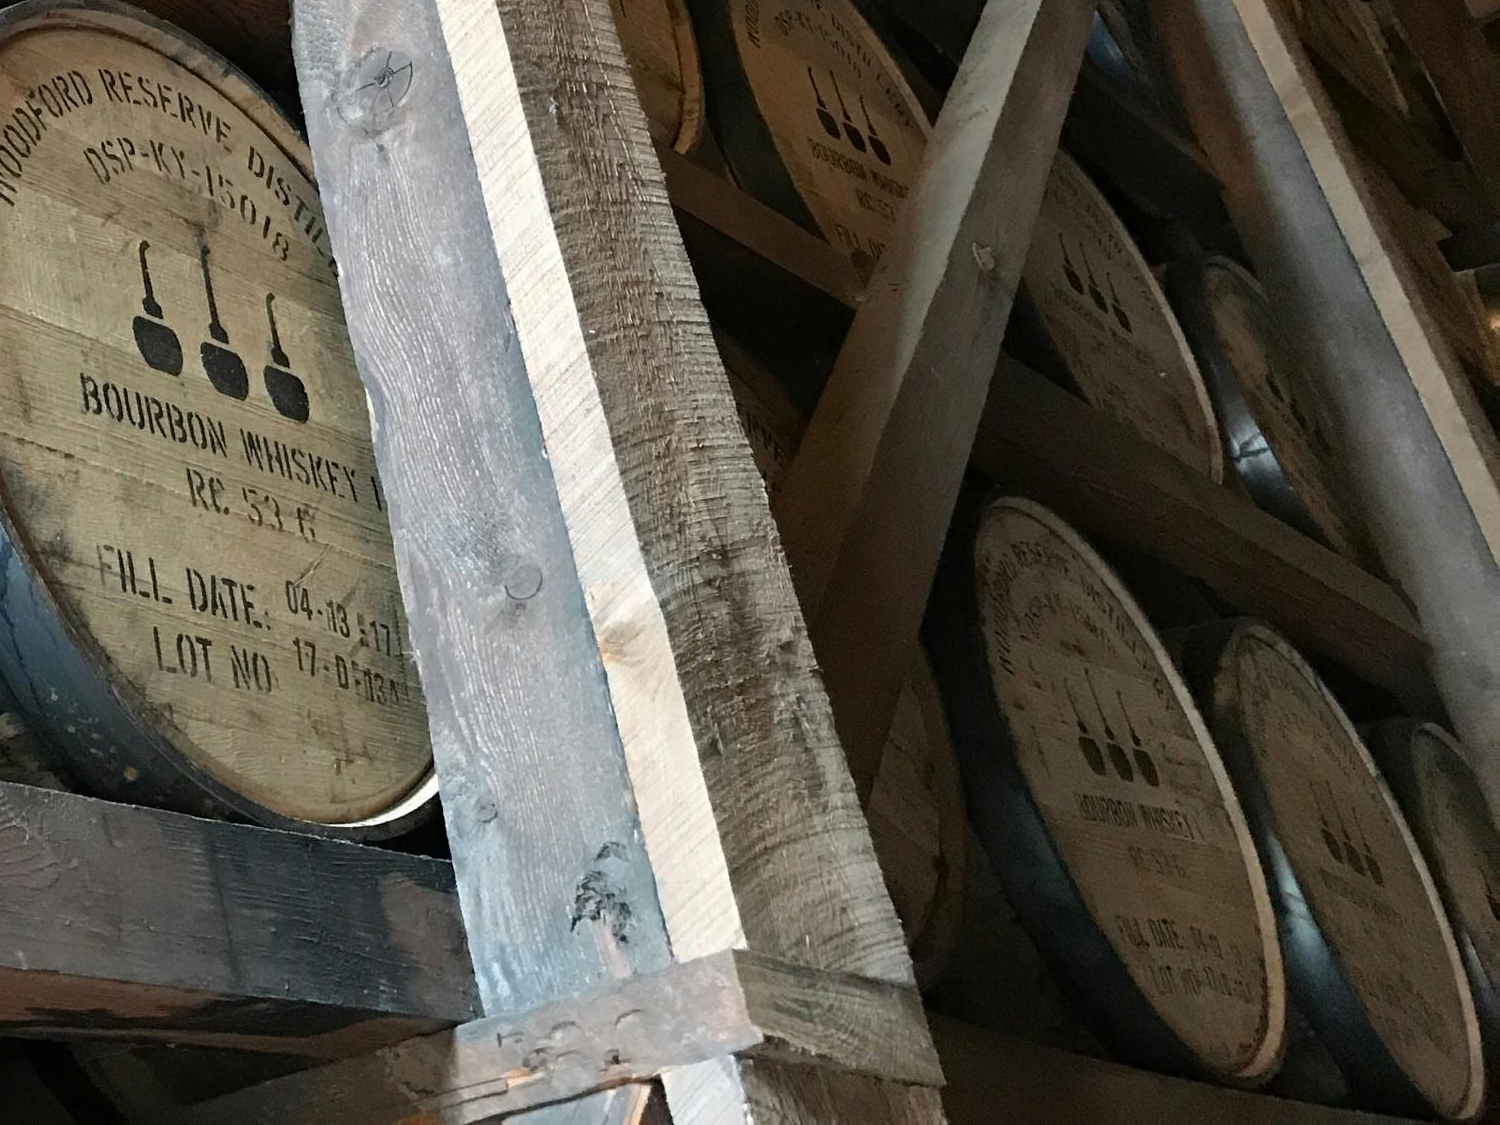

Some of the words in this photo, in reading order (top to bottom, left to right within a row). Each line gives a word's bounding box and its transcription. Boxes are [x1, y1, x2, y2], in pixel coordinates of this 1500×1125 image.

[97, 67, 232, 154] RESERVE
[84, 136, 289, 262] DSP-KY-15018
[79, 371, 228, 457] BOURBON
[240, 427, 358, 503] WHISKEY
[242, 486, 285, 533] 53
[95, 543, 173, 604] FILL
[152, 625, 213, 683] LOT
